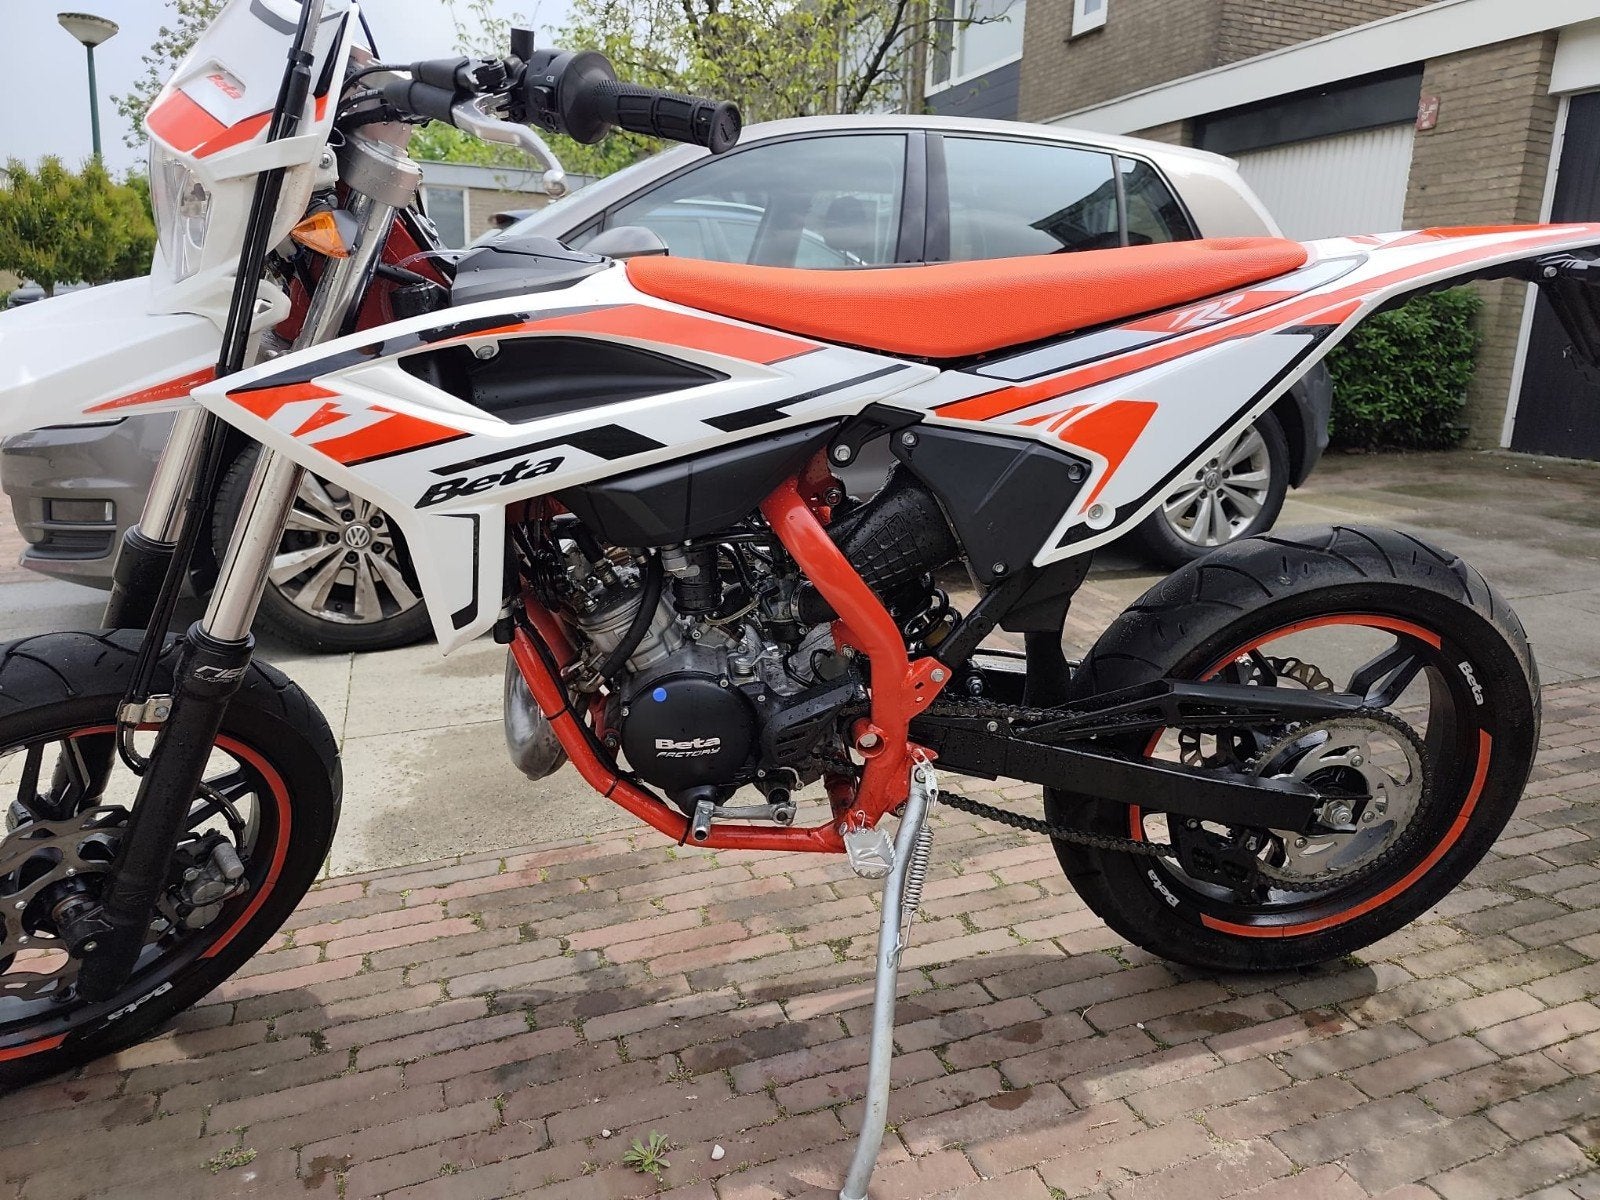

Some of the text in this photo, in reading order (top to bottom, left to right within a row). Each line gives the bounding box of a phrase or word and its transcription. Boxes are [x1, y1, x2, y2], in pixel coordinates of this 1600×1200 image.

[414, 456, 565, 509] Beta
[1458, 661, 1484, 706] Beta
[655, 737, 720, 750] Beta
[1147, 869, 1180, 908] Beta
